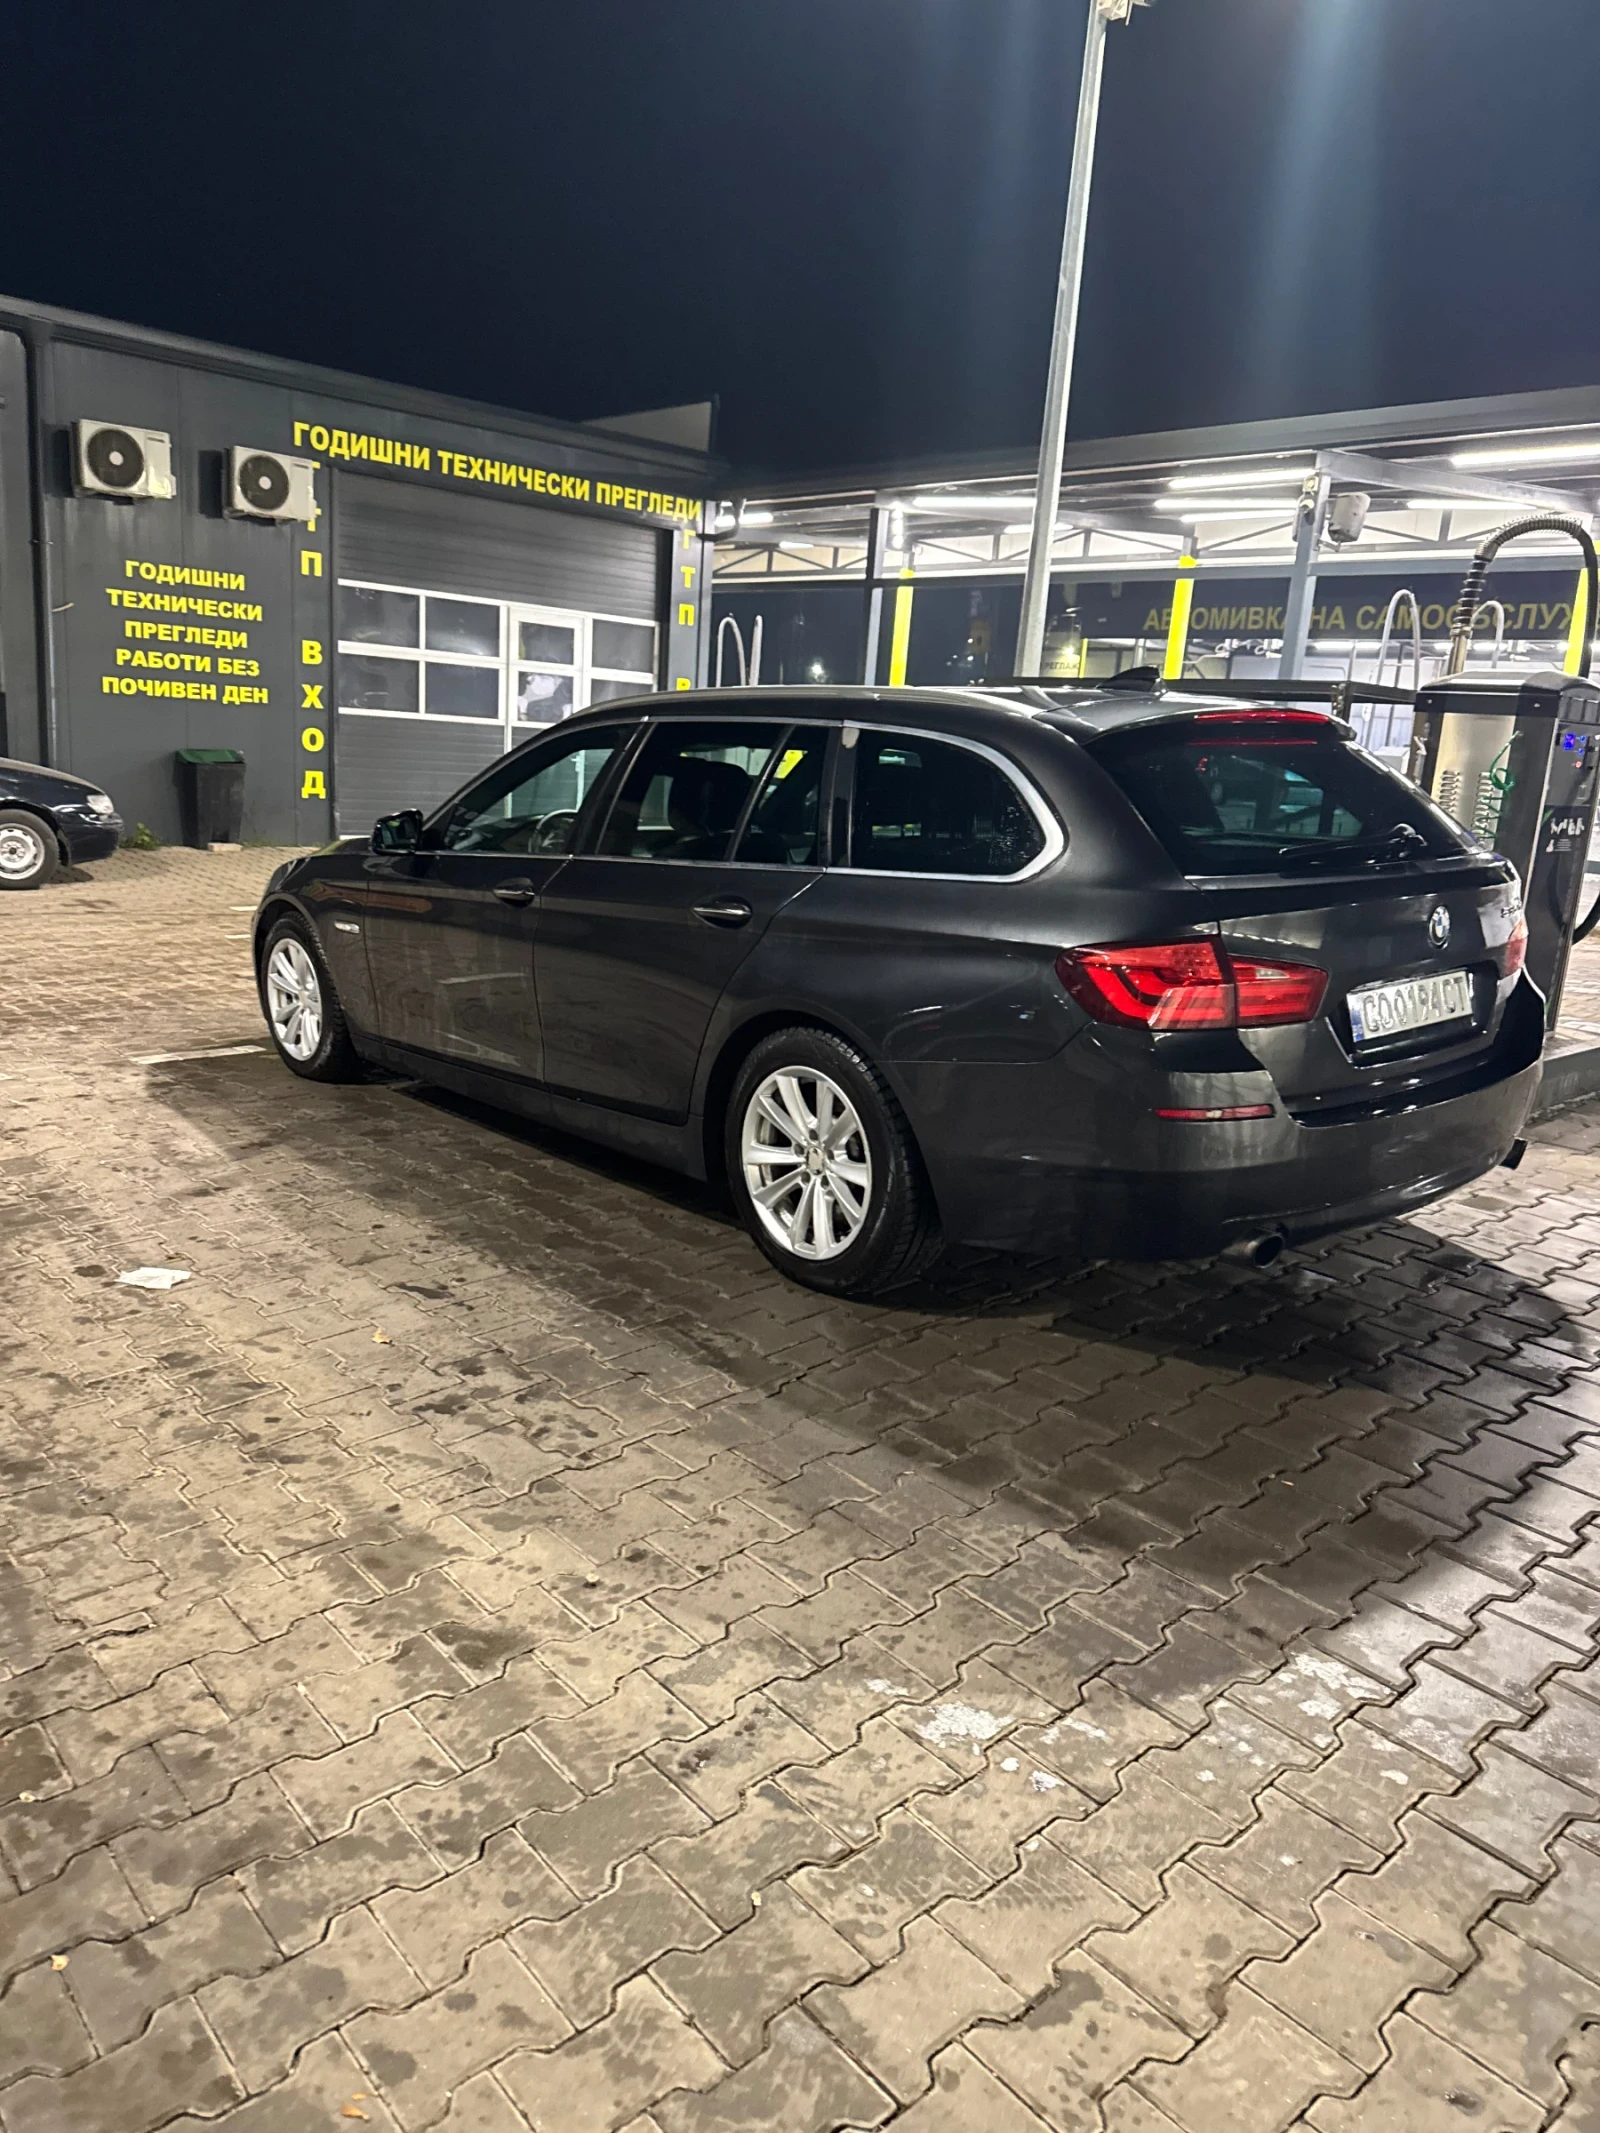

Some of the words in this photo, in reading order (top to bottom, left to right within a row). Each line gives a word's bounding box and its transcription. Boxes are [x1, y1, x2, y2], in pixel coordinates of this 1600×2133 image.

[293, 421, 430, 471] ГОДИШНИ
[437, 450, 590, 500] ТЕХНИЧЕСКИ
[596, 481, 702, 523] ПРЕГЛЕДИ
[125, 560, 246, 591] ГОДИШНИ
[678, 528, 697, 626] ГТП
[107, 588, 263, 621] ТЕХНИЧЕСКИ
[1143, 606, 1287, 631] АВОМИВК
[1309, 605, 1346, 630] НА
[124, 620, 248, 649] ПРЕГЛЕДИ
[116, 648, 212, 672] РАБОТИ
[218, 657, 260, 677] БЕЗ
[102, 676, 217, 702] ПОЧИВЕН
[222, 685, 269, 705] ДЕН
[300, 639, 327, 799] ВХОД
